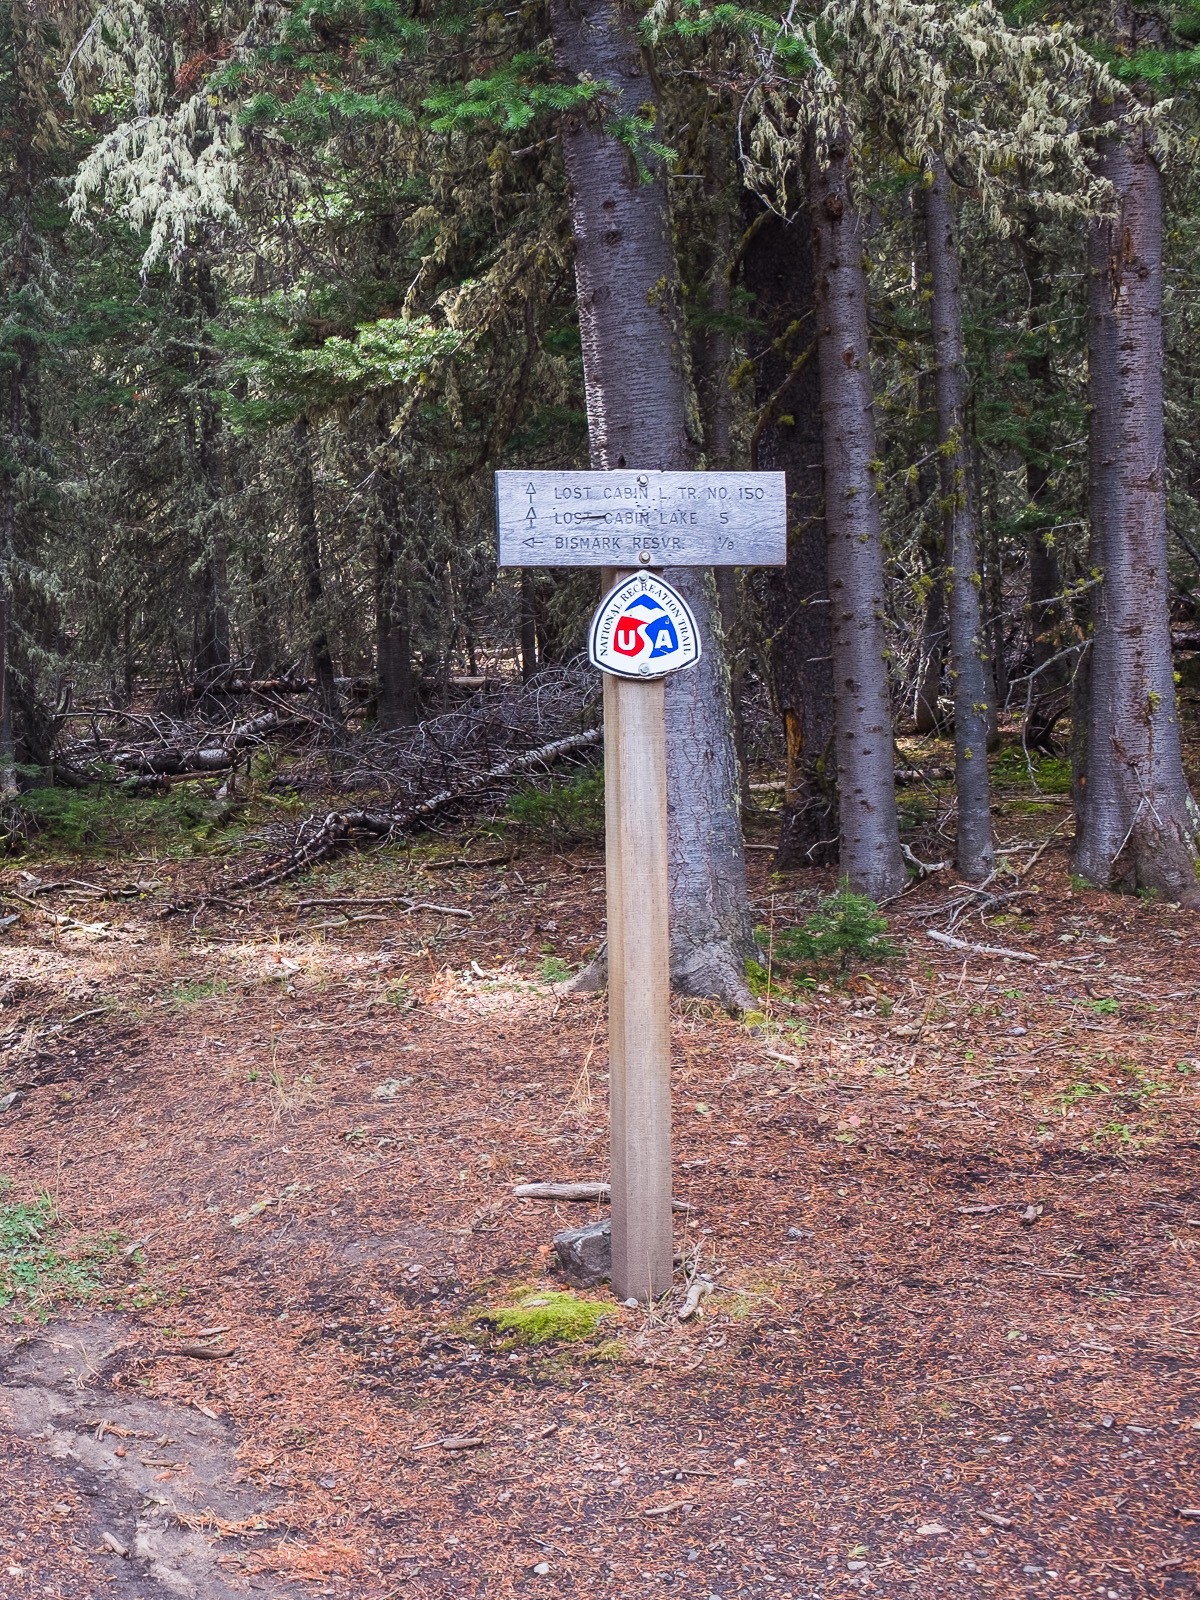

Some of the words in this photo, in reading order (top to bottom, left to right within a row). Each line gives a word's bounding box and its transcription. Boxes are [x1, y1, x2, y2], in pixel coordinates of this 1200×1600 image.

[554, 487, 592, 500] LOST
[603, 487, 648, 500] CABIN
[659, 487, 671, 500] L.
[678, 487, 700, 500] TR.
[707, 487, 731, 500] NO.
[738, 487, 765, 500] 150
[554, 512, 593, 525] LOST
[604, 512, 650, 525] CABIN
[660, 512, 698, 525] LAKE
[719, 512, 730, 525] 5
[555, 537, 621, 549] BISMARK
[632, 537, 685, 550] RESVR.
[600, 603, 623, 656] NATIONAL
[620, 582, 682, 618] RECREATION
[678, 619, 691, 655] TRAIL
[617, 625, 674, 655] USA
